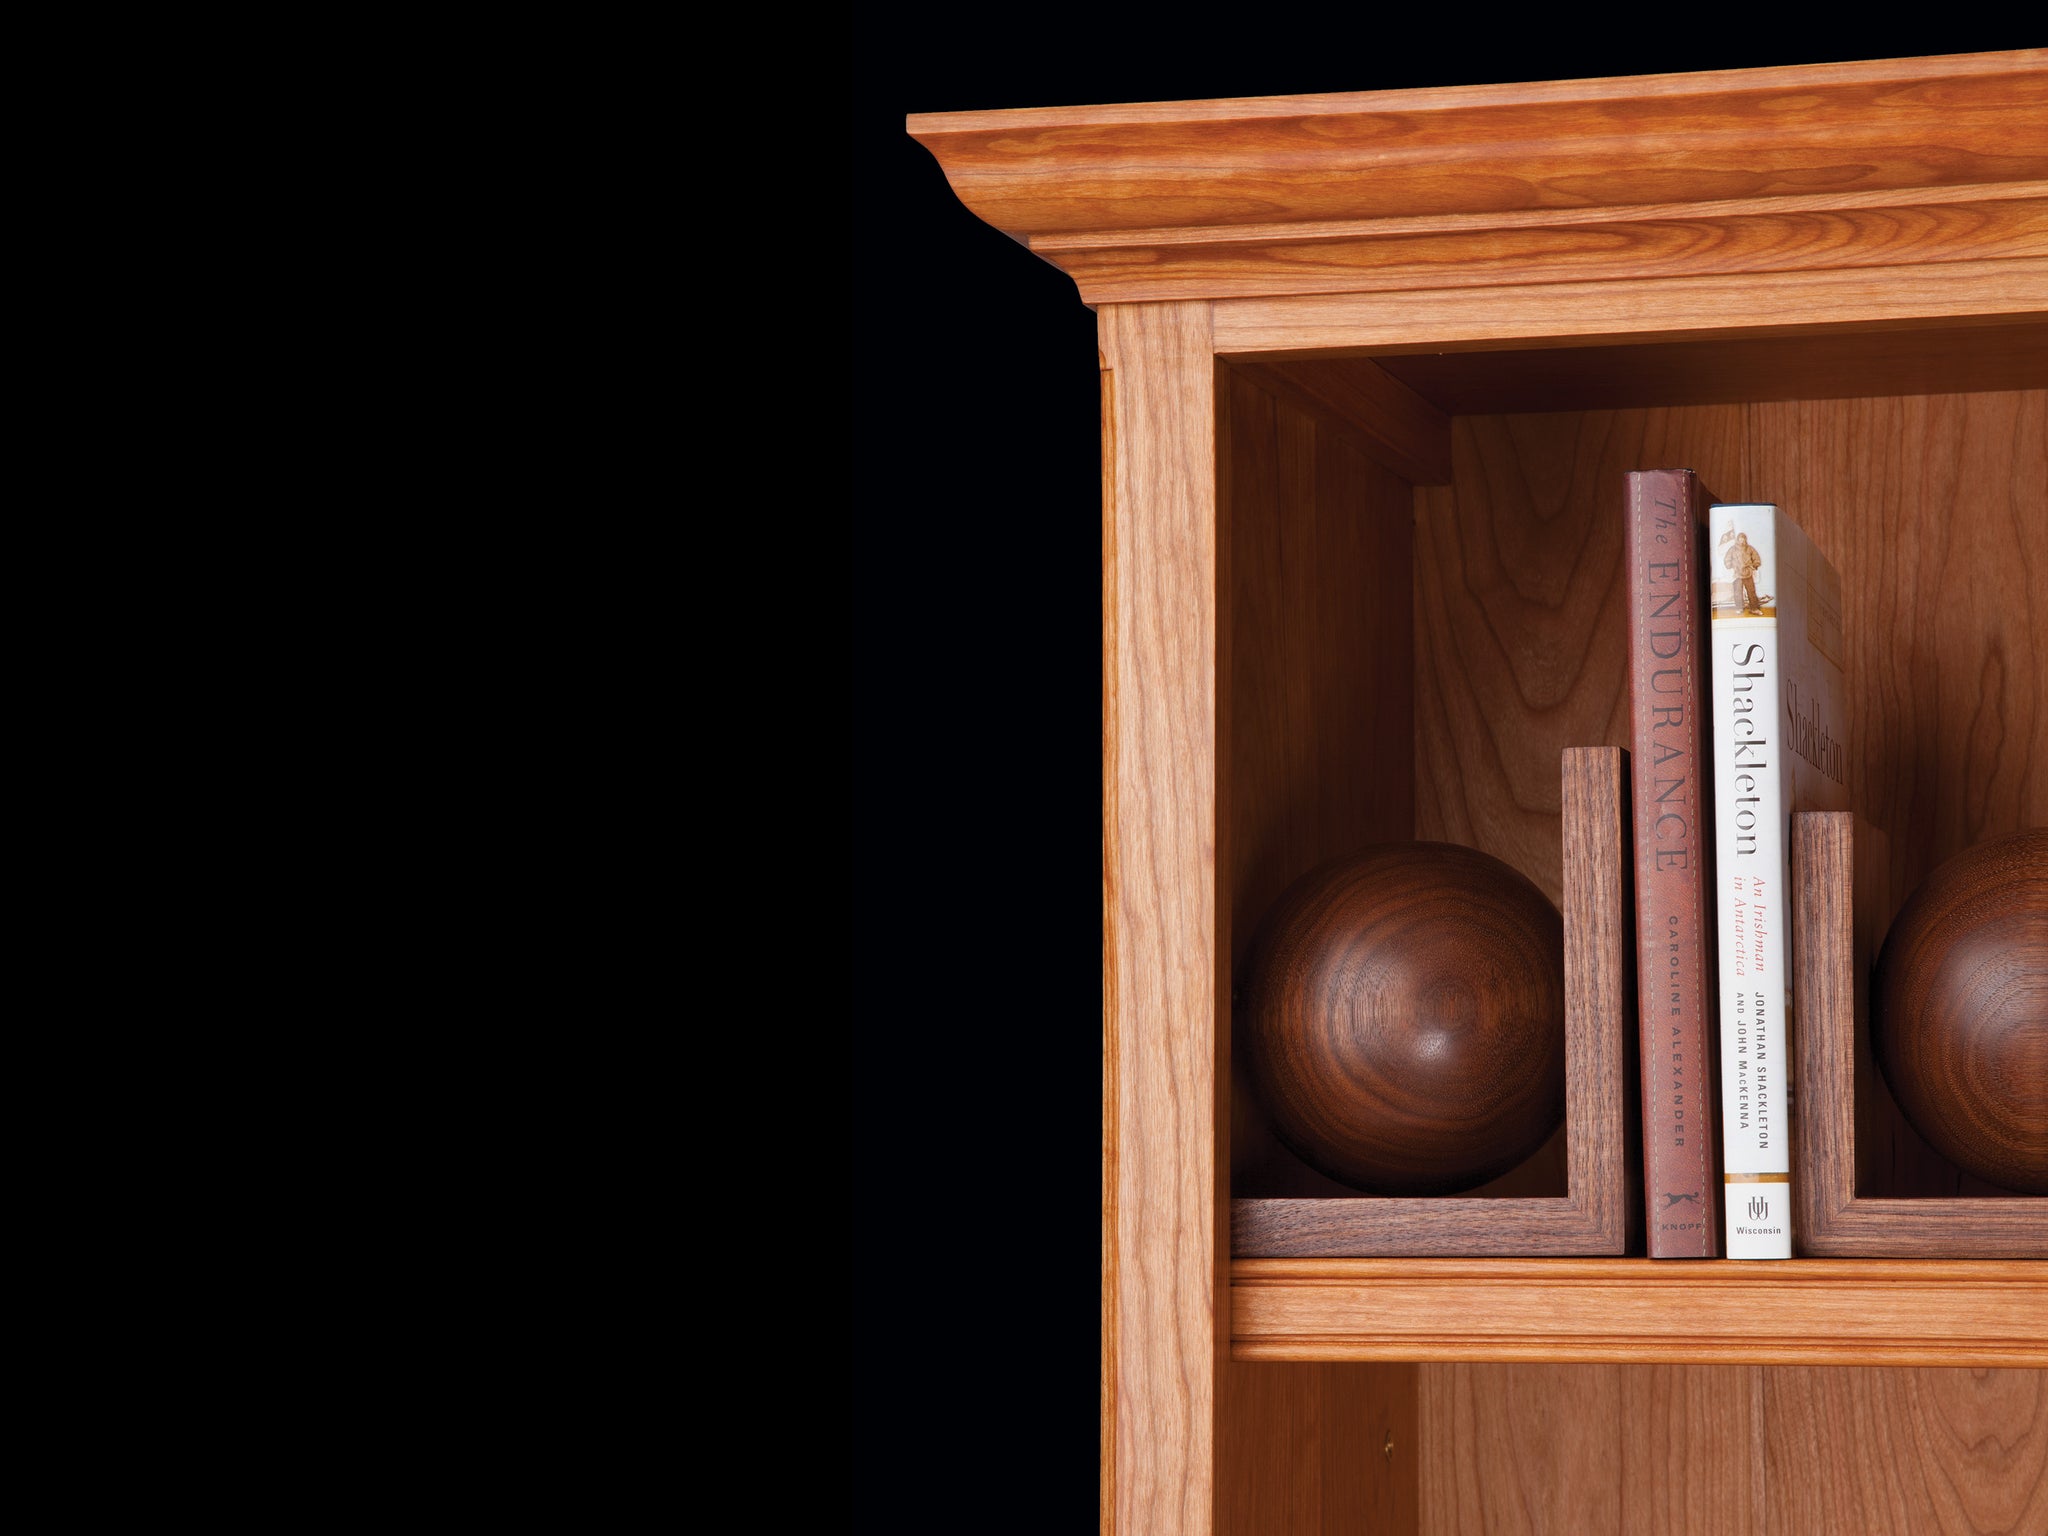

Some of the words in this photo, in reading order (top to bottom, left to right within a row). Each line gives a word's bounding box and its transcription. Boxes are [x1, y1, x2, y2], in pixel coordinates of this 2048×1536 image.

[1654, 498, 1677, 545] The
[1649, 559, 1688, 872] ENDURANCE
[1786, 678, 1844, 785] Shackleton
[1731, 643, 1768, 858] Shackleton
[1734, 876, 1747, 891] in
[1753, 876, 1767, 897] An
[1668, 915, 1681, 1016] CAROLINE
[1734, 897, 1748, 976] Antarctica
[1753, 903, 1768, 972] Irishman
[1736, 992, 1745, 1014] AND
[1737, 1020, 1748, 1054] JOHN
[1755, 991, 1767, 1060] JONATHAN
[1672, 1027, 1685, 1147] ALEXANDER
[1756, 1066, 1769, 1149] SHACKLETON
[1661, 1223, 1702, 1231] KNOPF
[1736, 1226, 1781, 1235] Wisconsin
